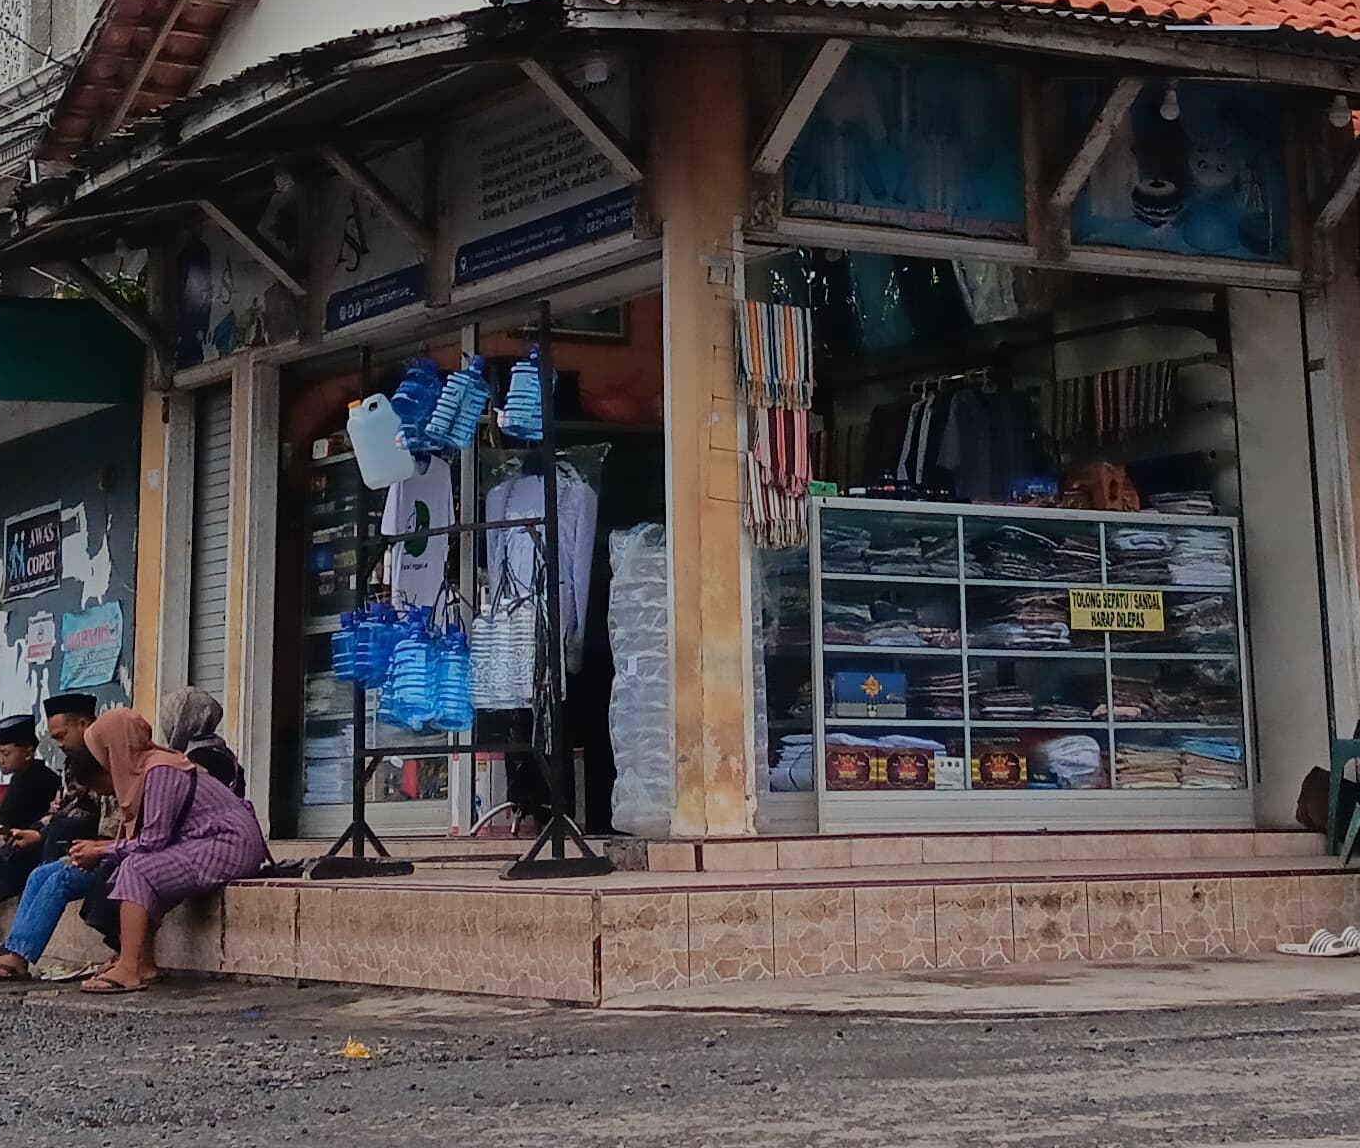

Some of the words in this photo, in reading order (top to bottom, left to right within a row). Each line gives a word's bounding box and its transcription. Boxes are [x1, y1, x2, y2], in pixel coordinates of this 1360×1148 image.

[27, 551, 56, 576] COPET
[1071, 591, 1101, 608] TOLONG
[1103, 592, 1129, 609] SEPATU
[1134, 593, 1161, 610] SANDAL
[1090, 611, 1115, 627] HARAP
[1116, 612, 1145, 628] DILEPAS
